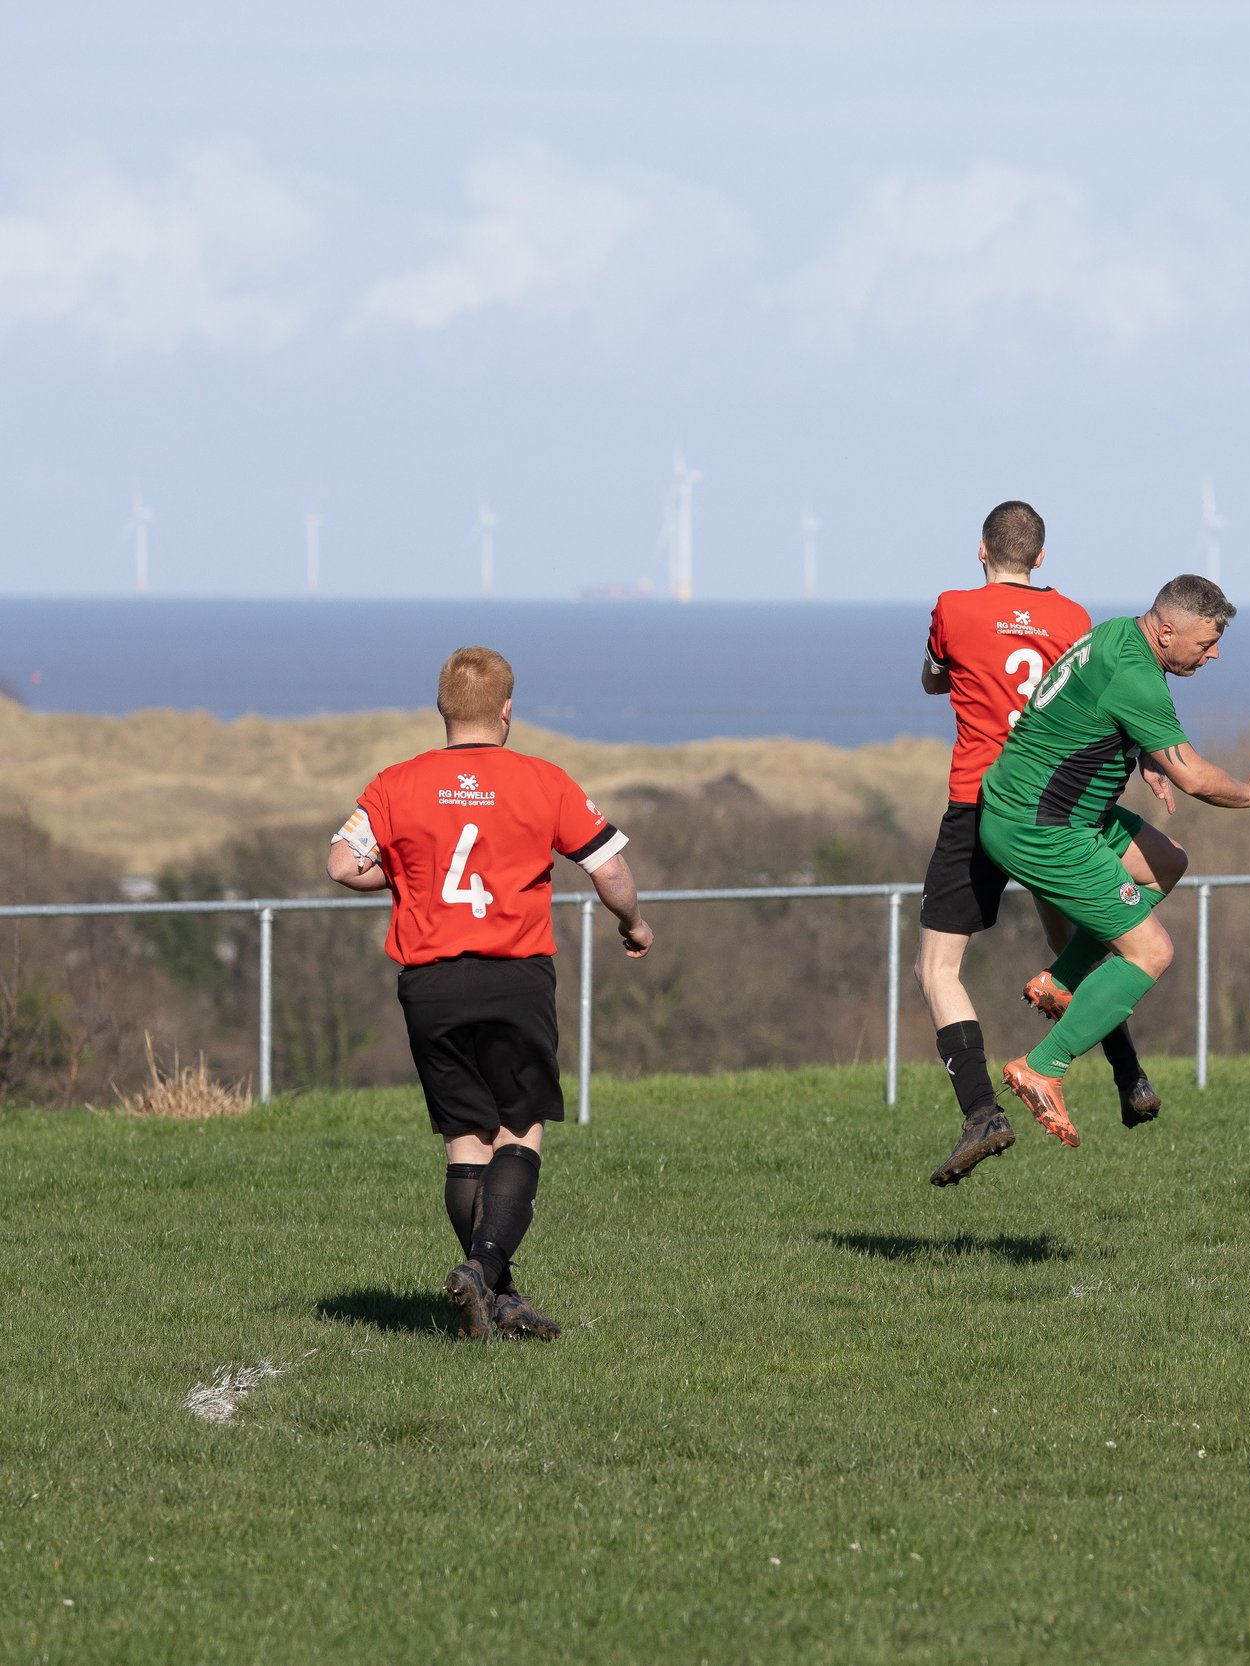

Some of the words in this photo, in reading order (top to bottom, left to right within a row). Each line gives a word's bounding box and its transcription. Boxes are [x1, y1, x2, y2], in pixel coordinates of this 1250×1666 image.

[997, 621, 1009, 629] RG
[997, 628, 1024, 636] cleaning
[1005, 648, 1043, 728] 3
[439, 790, 452, 798] RG
[454, 790, 496, 800] HOWELLS
[439, 798, 467, 807] cleaning
[442, 823, 494, 919] 4
